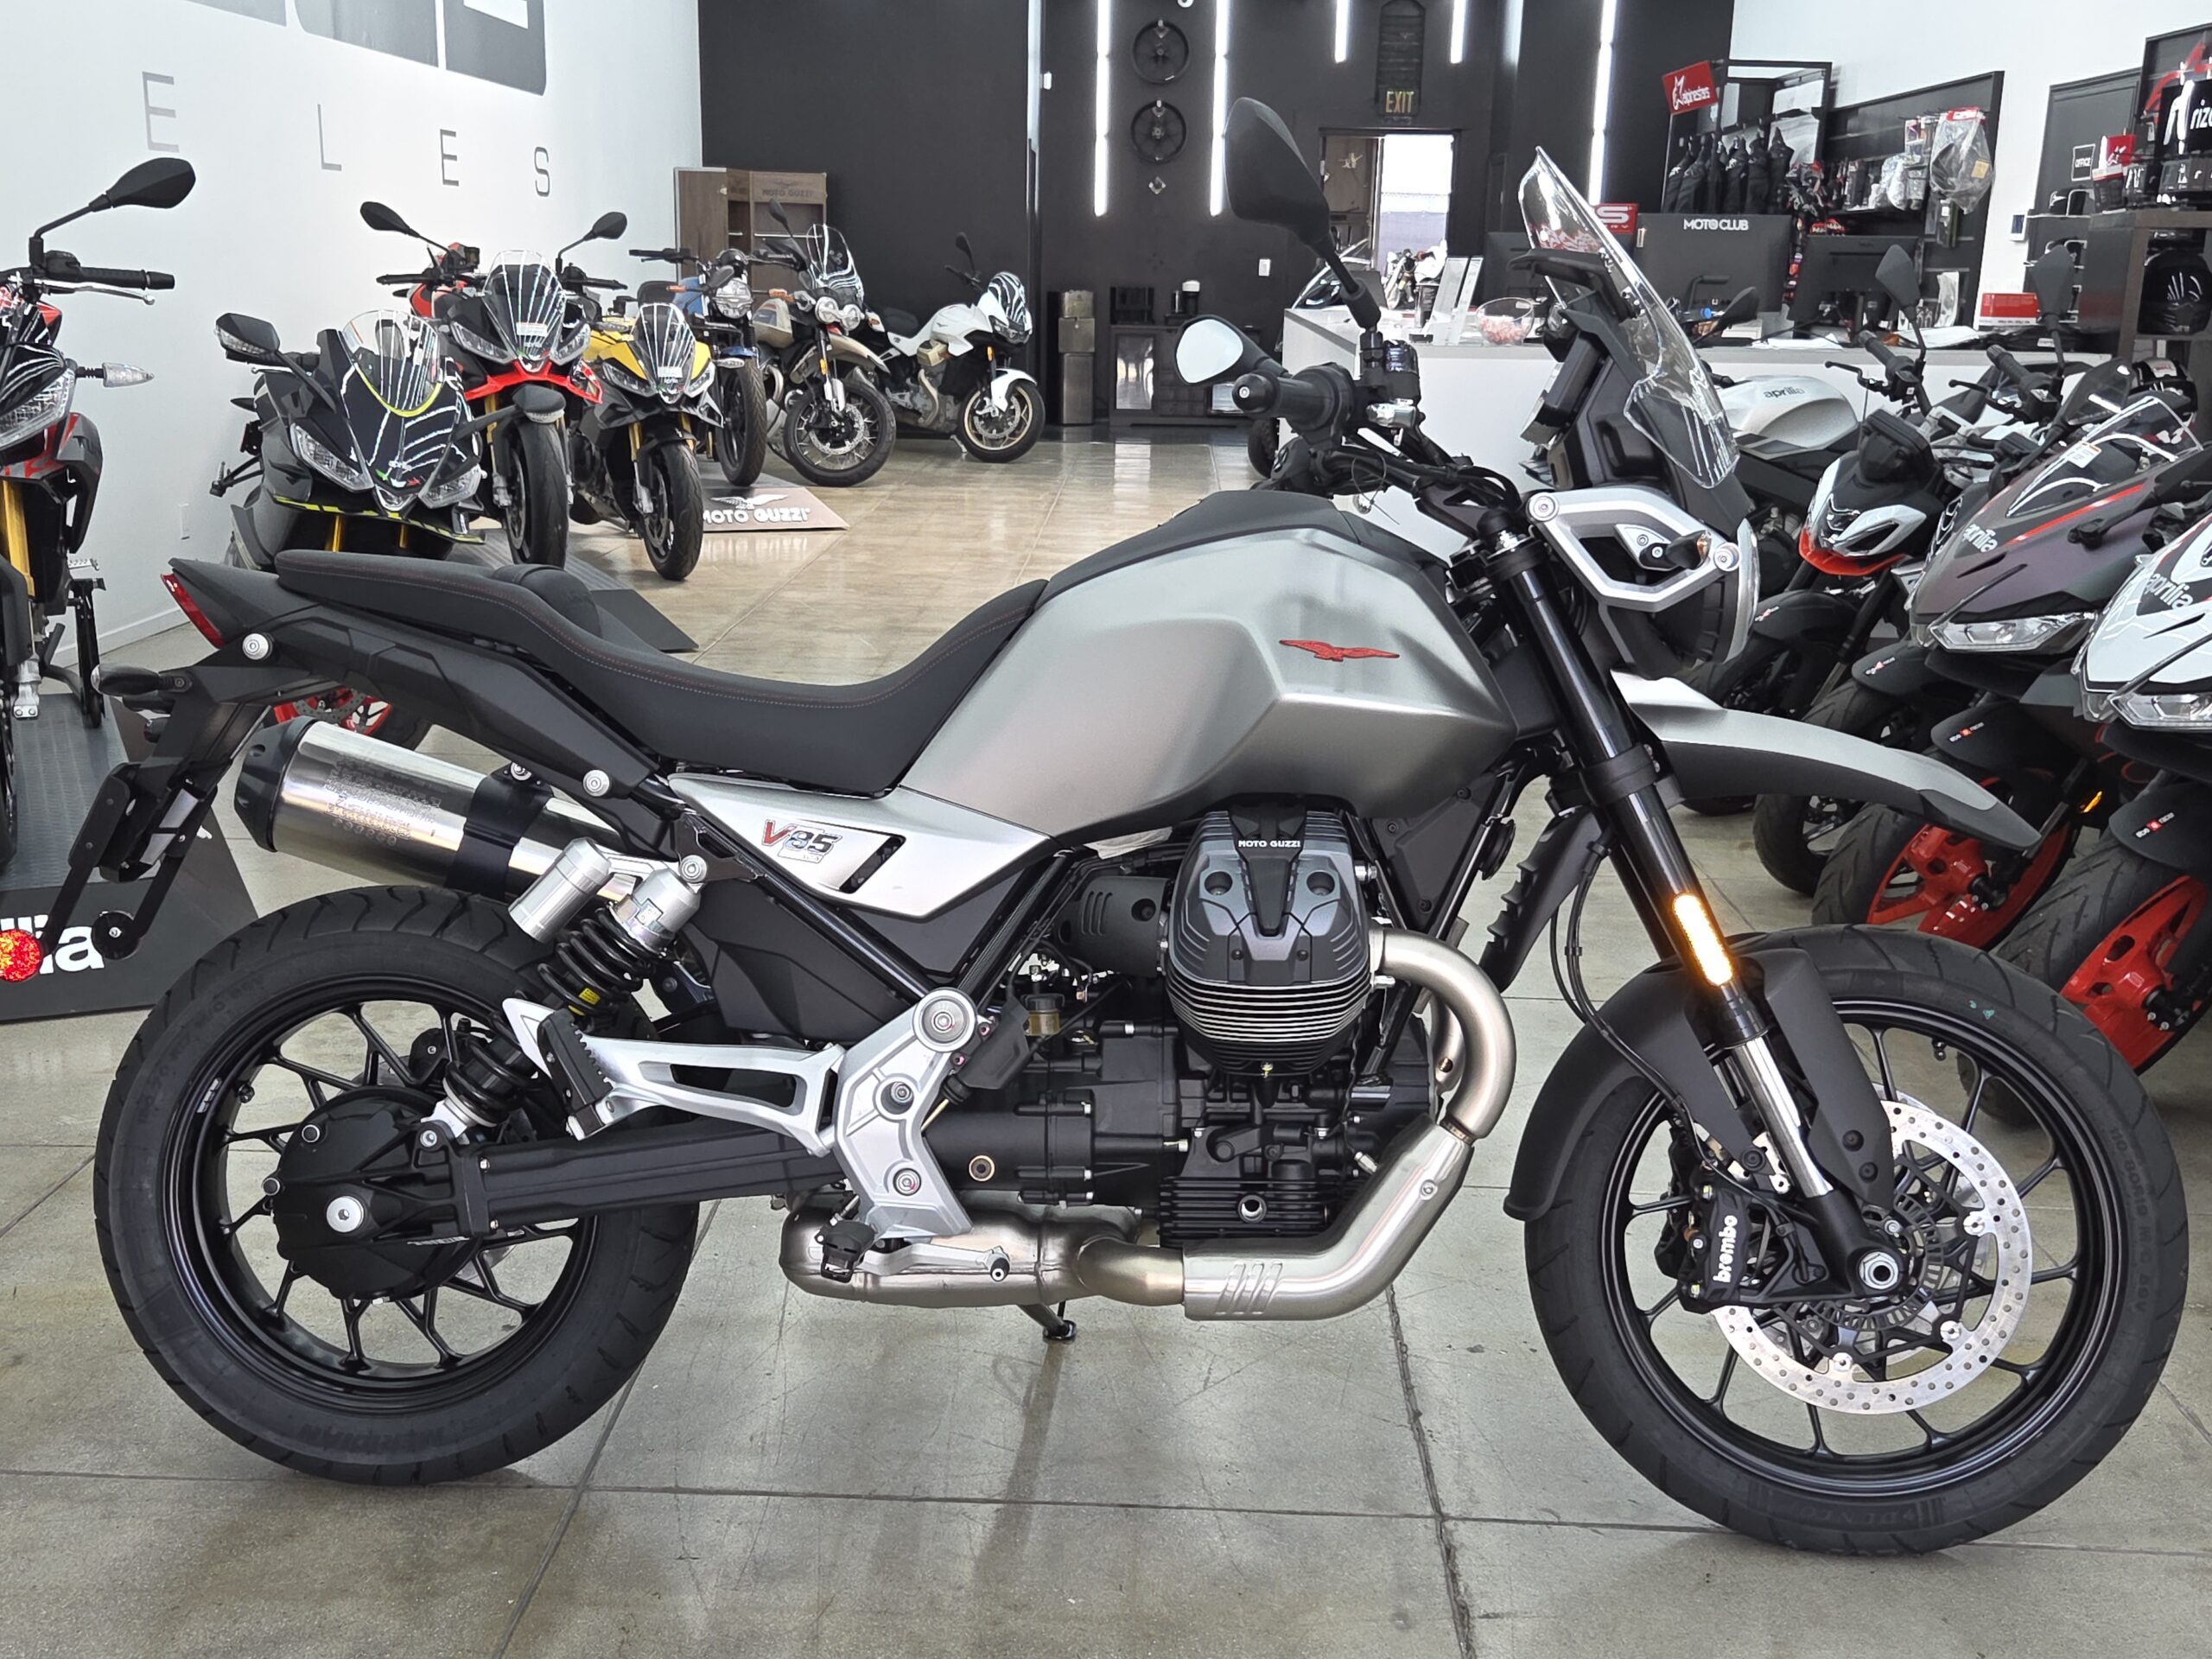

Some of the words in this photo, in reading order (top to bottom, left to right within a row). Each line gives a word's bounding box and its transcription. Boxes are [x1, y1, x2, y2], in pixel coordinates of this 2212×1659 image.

[1386, 91, 1414, 113] EXIT
[2075, 157, 2091, 168] OFFICE
[761, 189, 785, 198] MOTO
[788, 189, 812, 198] GUZZI
[1763, 386, 1805, 397] aprilia
[754, 507, 809, 523] GUZZI
[1962, 524, 1998, 553] aprilia
[2145, 573, 2195, 609] aprilia
[764, 821, 839, 853] V85
[1713, 1215, 1738, 1283] brembo
